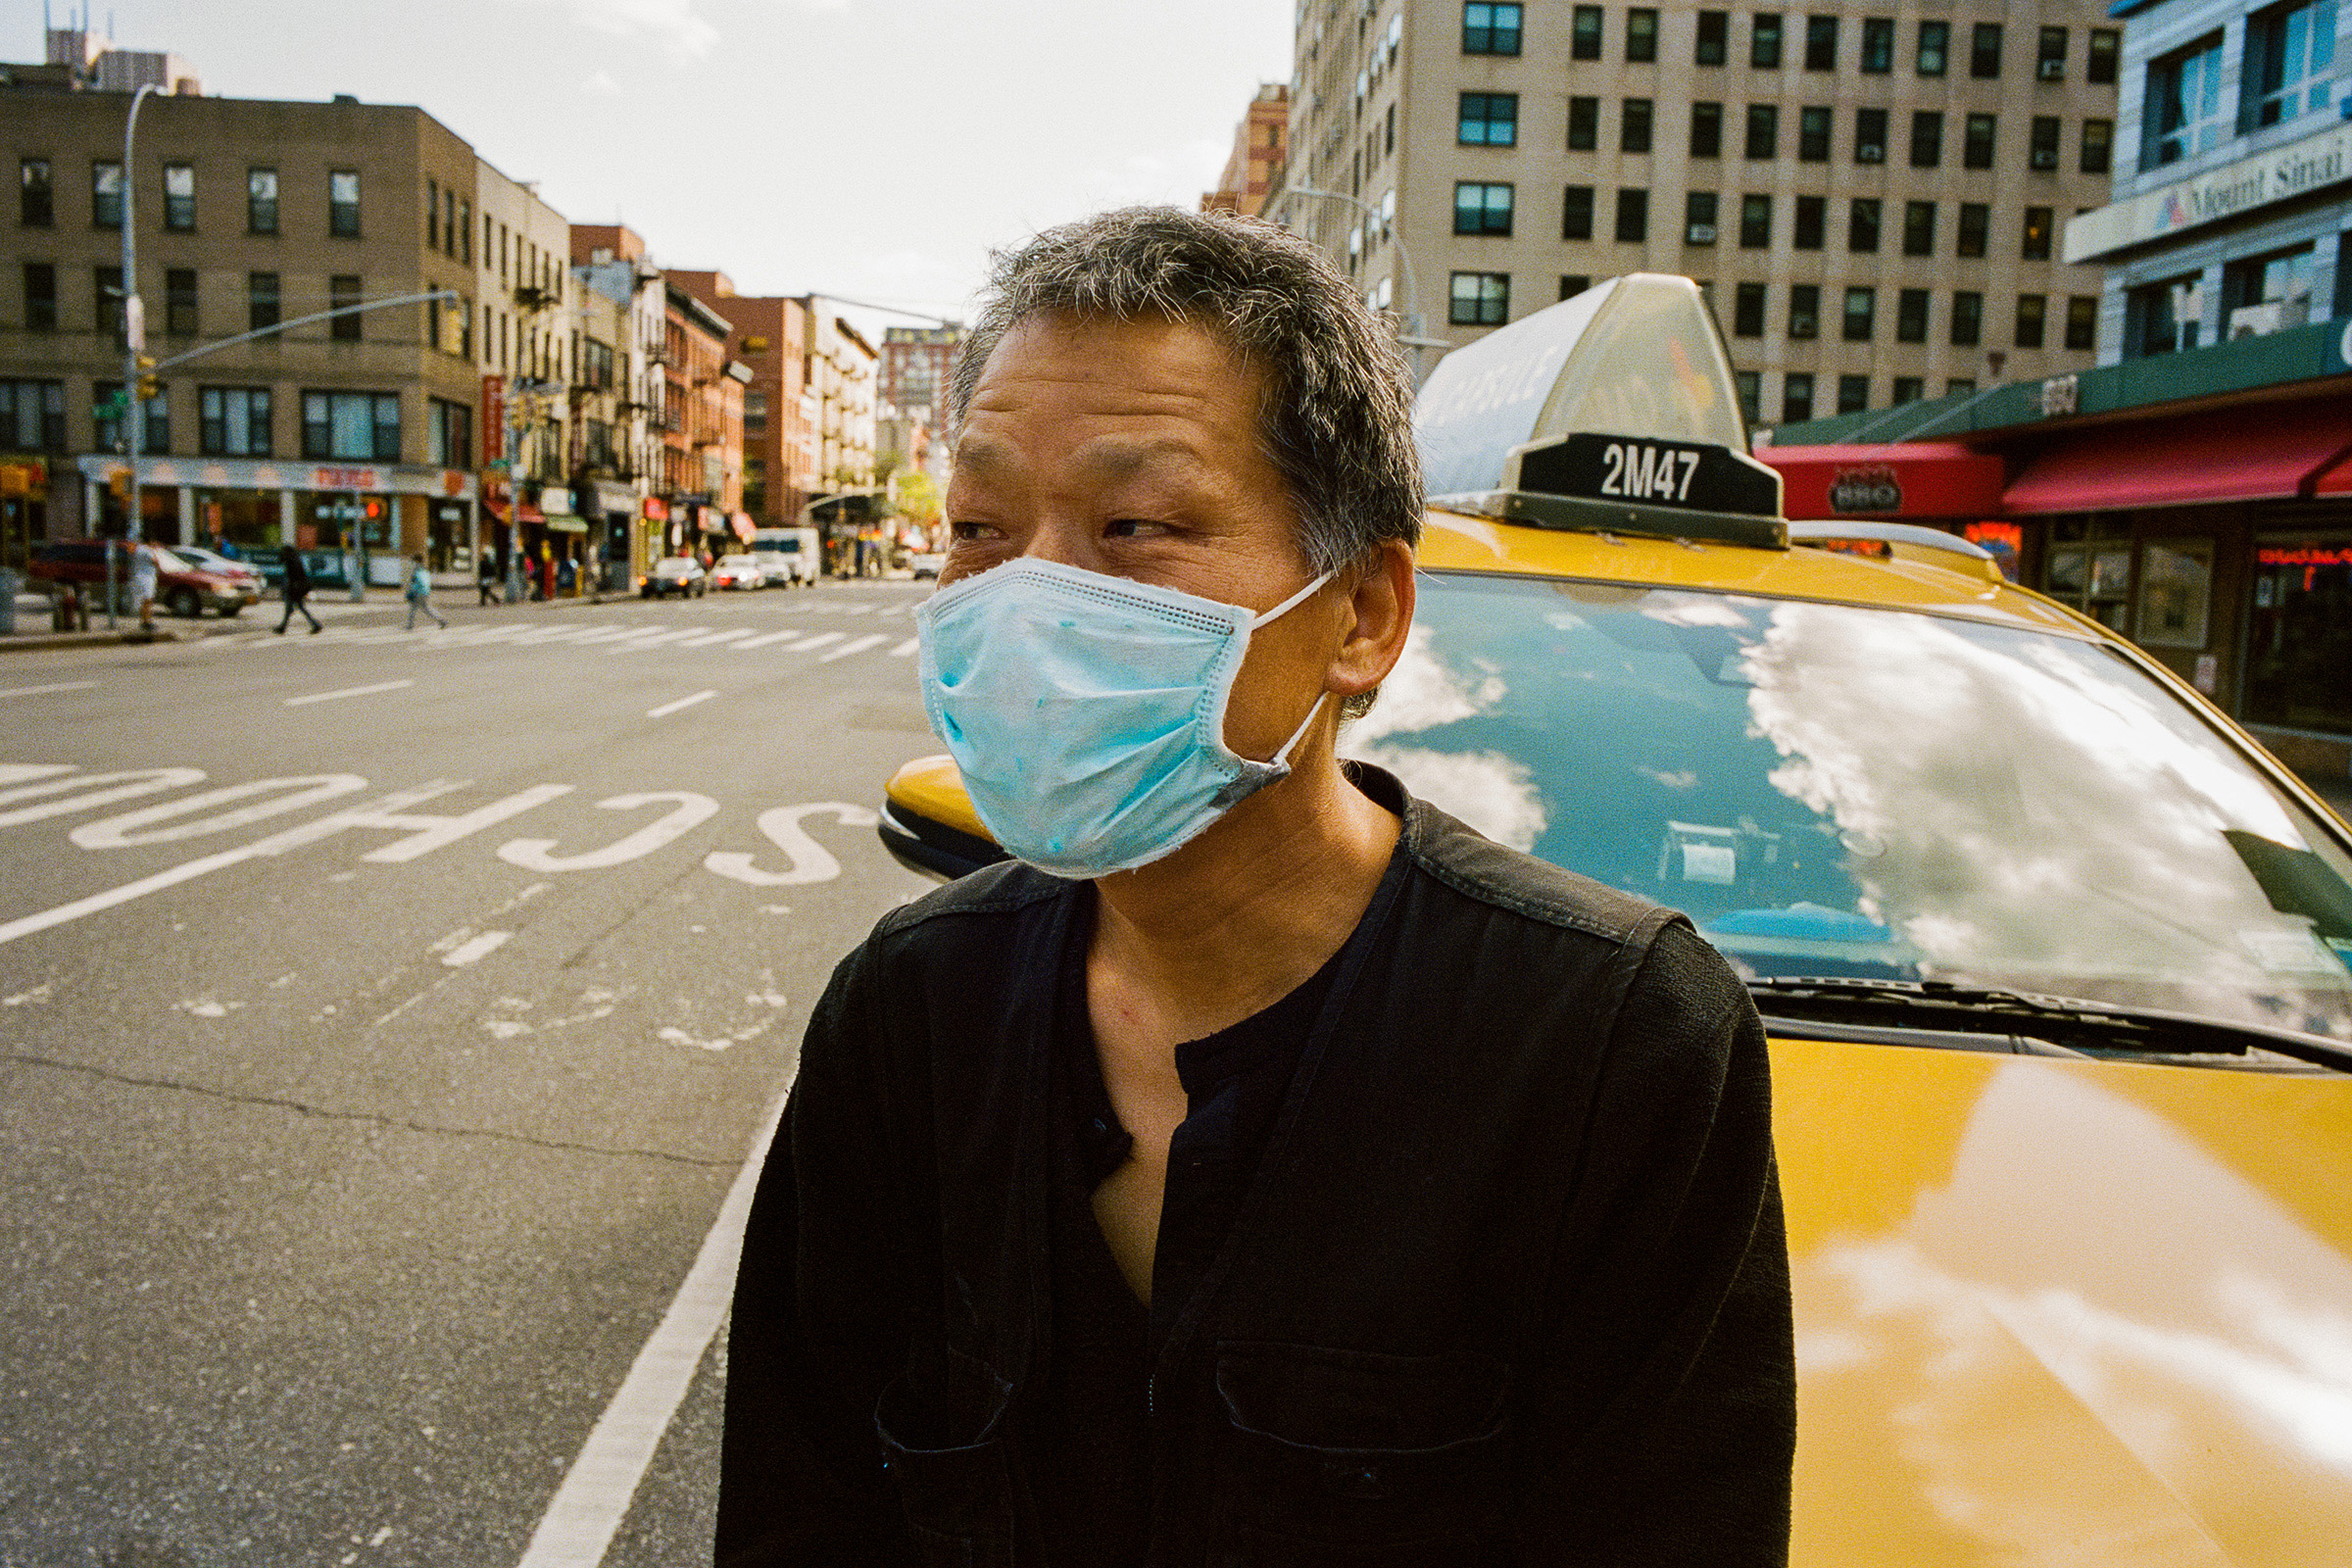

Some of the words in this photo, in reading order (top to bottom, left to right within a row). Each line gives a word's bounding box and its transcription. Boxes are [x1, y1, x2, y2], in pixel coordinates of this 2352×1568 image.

[2192, 169, 2266, 215] Mount
[2274, 138, 2344, 196] Sinai
[1600, 444, 1700, 502] 2M47
